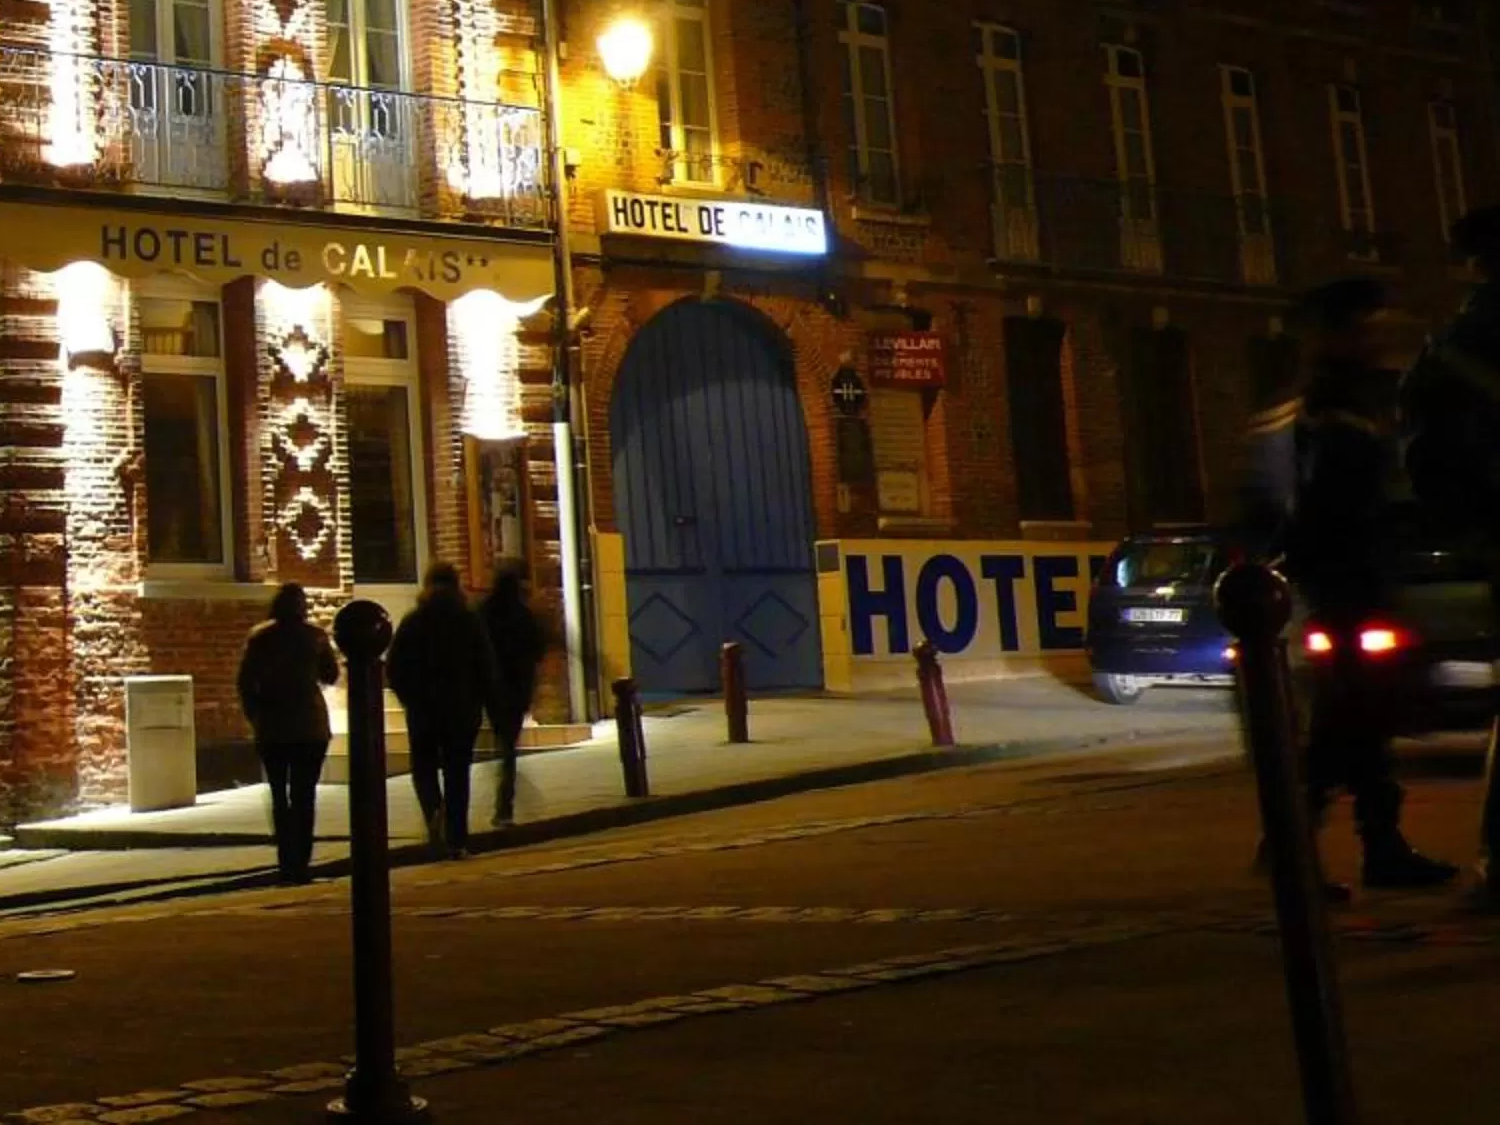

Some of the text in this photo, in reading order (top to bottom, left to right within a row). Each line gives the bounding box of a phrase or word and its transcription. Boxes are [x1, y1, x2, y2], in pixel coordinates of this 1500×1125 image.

[613, 196, 689, 234] HOTEL
[698, 206, 726, 236] DE
[101, 225, 242, 268] HOTEL
[261, 241, 302, 271] de
[845, 554, 1104, 654] HOTE
